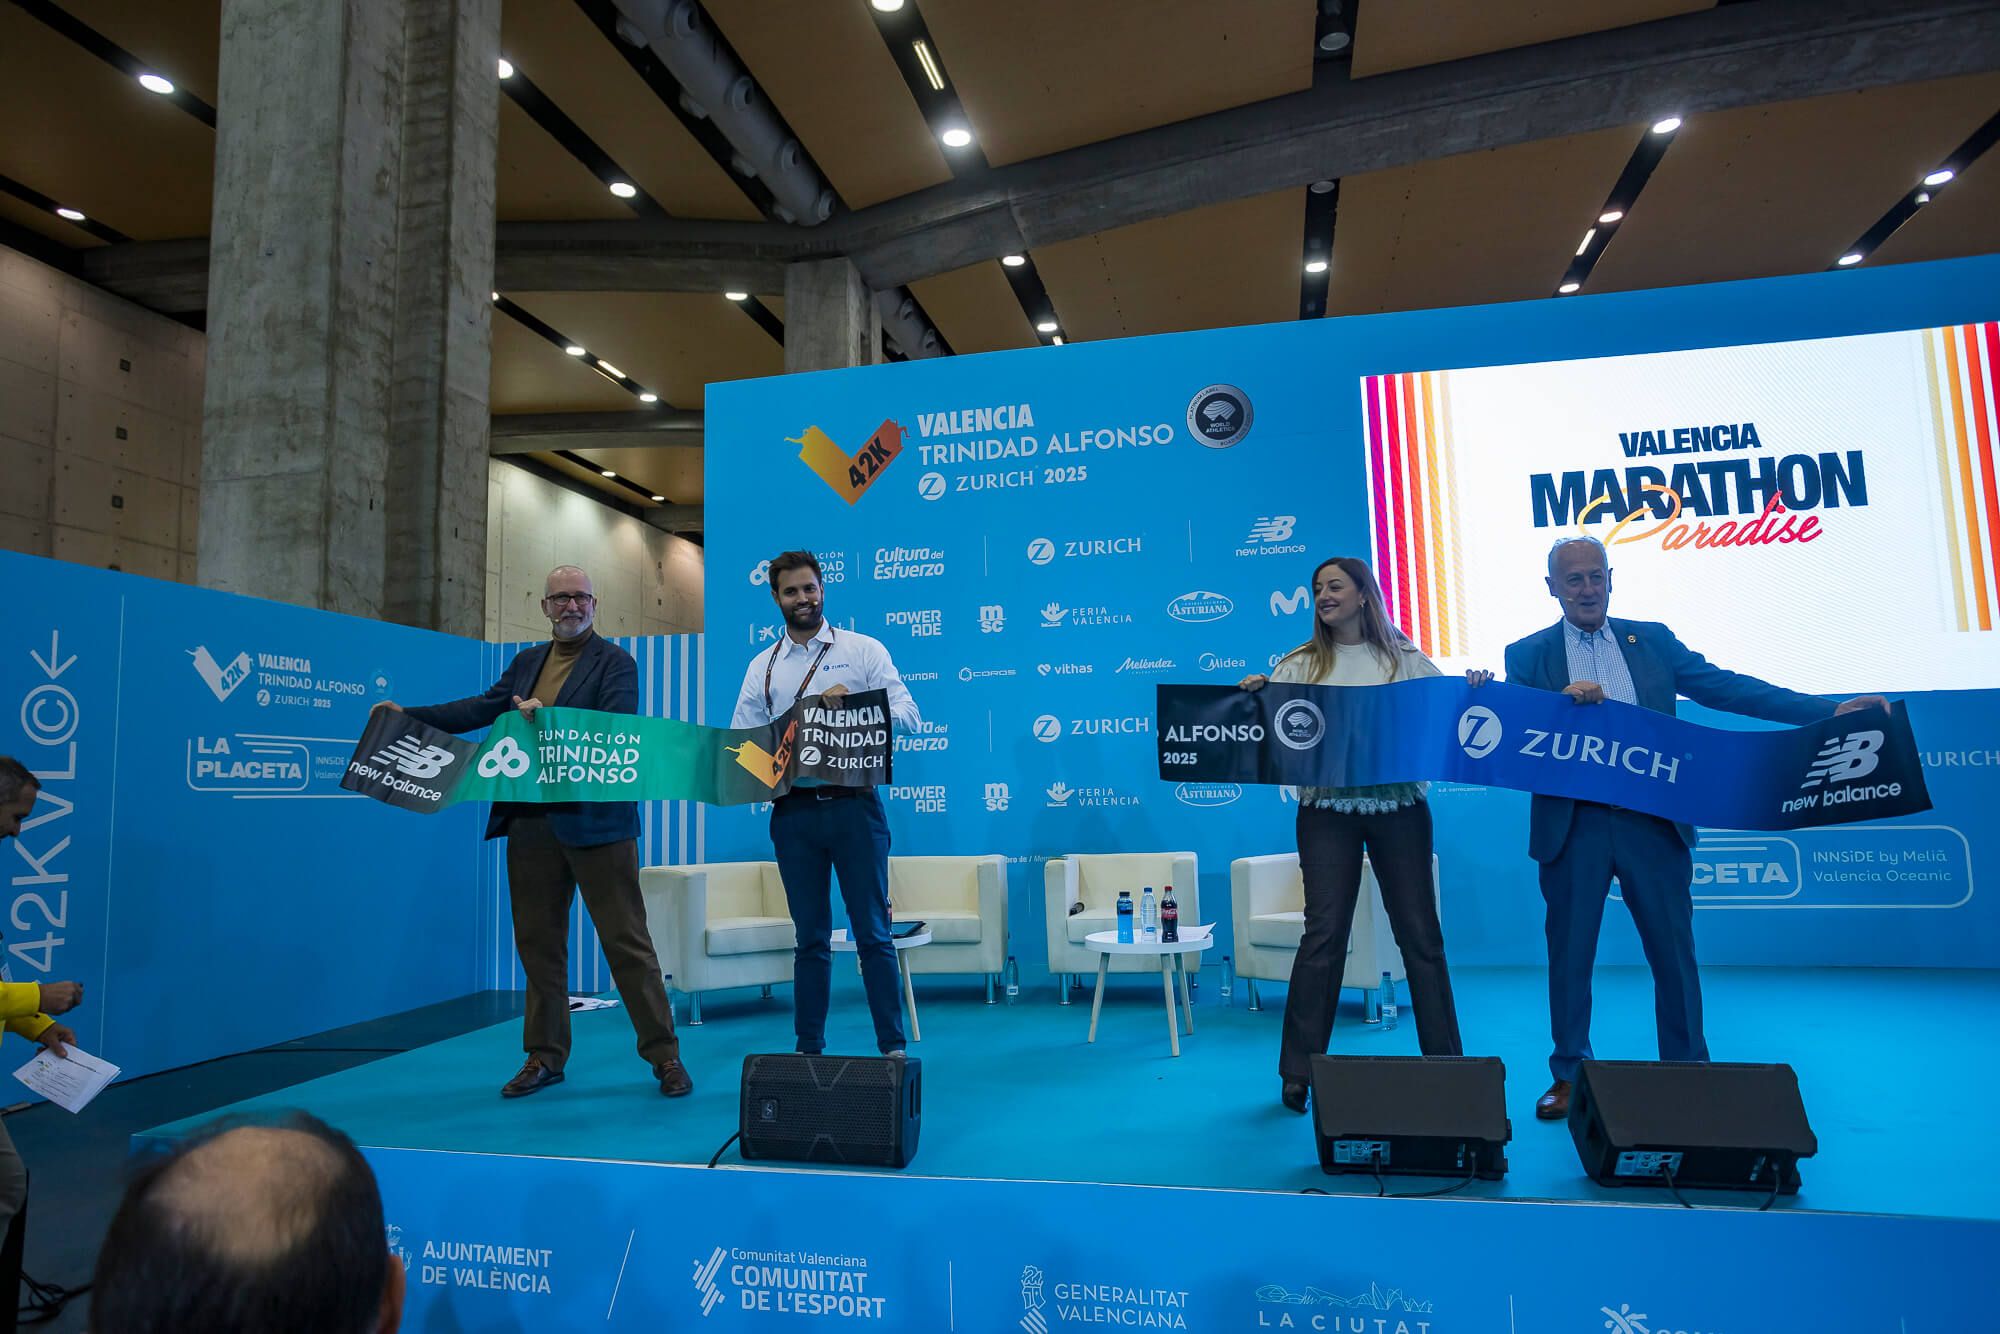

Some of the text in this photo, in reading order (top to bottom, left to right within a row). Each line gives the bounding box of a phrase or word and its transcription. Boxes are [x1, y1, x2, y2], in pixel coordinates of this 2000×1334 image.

[917, 403, 1034, 438] VALENCIA
[918, 423, 1174, 466] TRINIDAD ALFONSO
[1619, 422, 1761, 458] VALENCIA
[848, 437, 892, 490] 42K
[956, 470, 1034, 492] ZURICH
[1044, 466, 1087, 485] 2025
[1530, 450, 1868, 528] MARATHON
[1577, 484, 1823, 550] Paradise
[875, 547, 944, 564] Cultura del
[1064, 538, 1141, 557] ZURICH
[1235, 543, 1306, 557] new balance
[873, 562, 945, 580] Esfuerzo
[886, 610, 941, 626] POWER
[1072, 607, 1107, 616] FERIA
[1171, 603, 1228, 616] ASTURIANA
[1073, 615, 1132, 625] VALENCIA
[912, 623, 942, 637] ADE
[258, 653, 311, 673] VALENCIA
[1054, 663, 1093, 675] vithas
[1205, 656, 1246, 670] Midea
[220, 661, 243, 691] 42K
[258, 672, 312, 690] TRINIDAD
[315, 680, 365, 696] ALFONSO
[900, 673, 938, 681] YUNDAI
[274, 695, 310, 706] ZURICH
[312, 698, 331, 708] 2025
[803, 706, 886, 728] VALENCIA
[1071, 717, 1149, 735] ZURICH
[539, 729, 640, 745] FUNDACIÓN
[935, 724, 948, 733] del
[1165, 725, 1264, 742] ALFONSO
[197, 737, 231, 754] LA
[802, 728, 887, 749] TRINIDAD
[538, 745, 640, 766] TRINIDAD
[771, 736, 793, 777] 42K
[826, 755, 884, 769] ZURICH
[1163, 752, 1198, 765] 2025
[1519, 728, 1680, 784] ZURICH
[197, 761, 302, 779] PLACETA
[536, 764, 637, 784] ALFONSO
[349, 760, 442, 801] new balance
[889, 786, 946, 800] POWER
[1079, 787, 1114, 796] FERIA
[1079, 796, 1139, 806] VALENCIA
[1180, 788, 1236, 800] ASTURIANA
[1781, 783, 1901, 813] new balance
[915, 799, 946, 812] ADE
[1813, 851, 1874, 864] INNSiDE
[1879, 851, 1898, 865] by
[1692, 863, 1789, 884] CETA
[1814, 869, 1952, 882] Valencia Oceanic
[422, 1240, 552, 1268] AJUNTAMENT
[731, 1247, 867, 1268] Comunitat Valenciana
[422, 1265, 551, 1294] DE VALÈNCIA
[731, 1265, 867, 1293] COMUNITAT
[741, 1289, 886, 1318] DE L'ESPORT
[1055, 1283, 1189, 1308] GENERALITAT
[1056, 1304, 1187, 1330] VALENCIANA
[1259, 1310, 1430, 1334] LA CIUTAT
